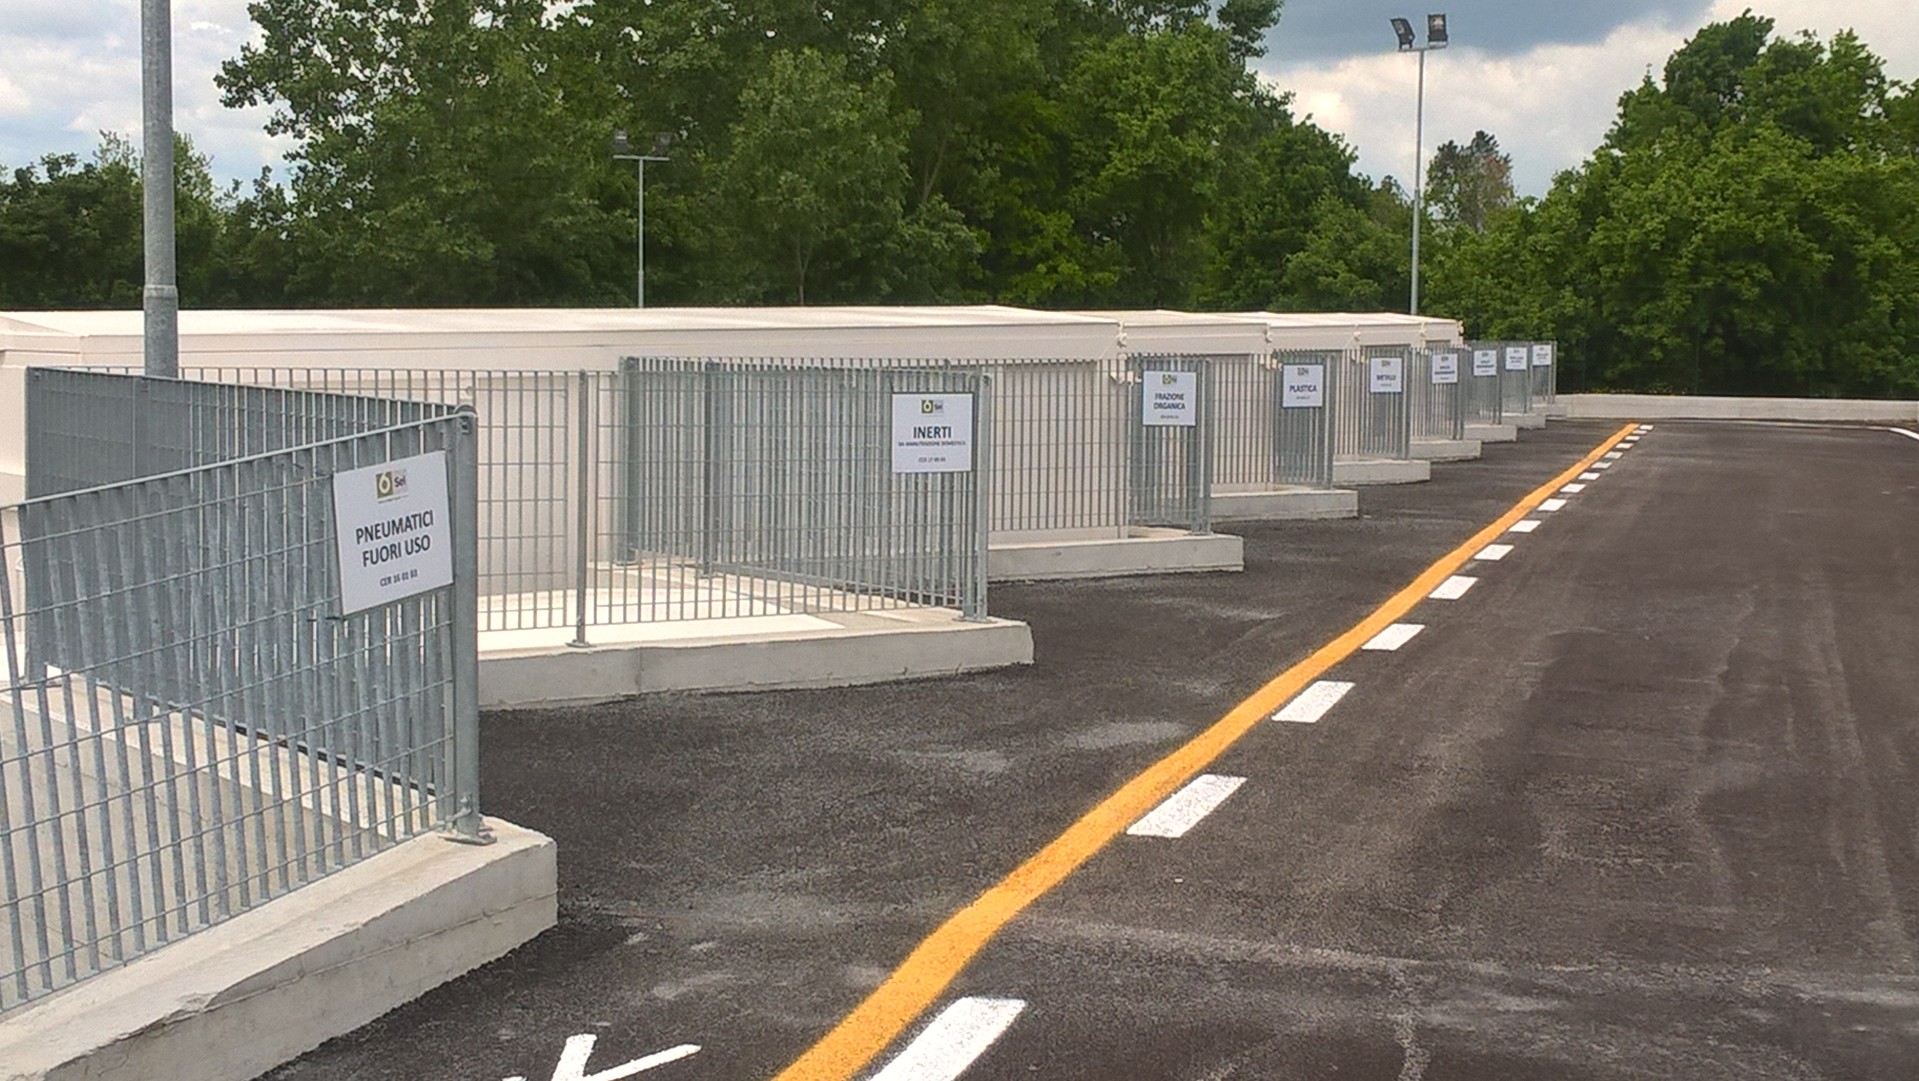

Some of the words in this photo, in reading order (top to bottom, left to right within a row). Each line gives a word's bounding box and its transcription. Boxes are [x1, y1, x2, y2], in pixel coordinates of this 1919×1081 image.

[1289, 384, 1317, 393] PLASTICA
[1155, 393, 1184, 401] FRAZIONE
[1153, 402, 1186, 410] ORGANICA
[913, 426, 952, 439] INERTI
[356, 509, 434, 545] PNEUMATICI
[362, 542, 402, 567] FUORI
[405, 534, 431, 556] USO
[380, 576, 392, 587] CER
